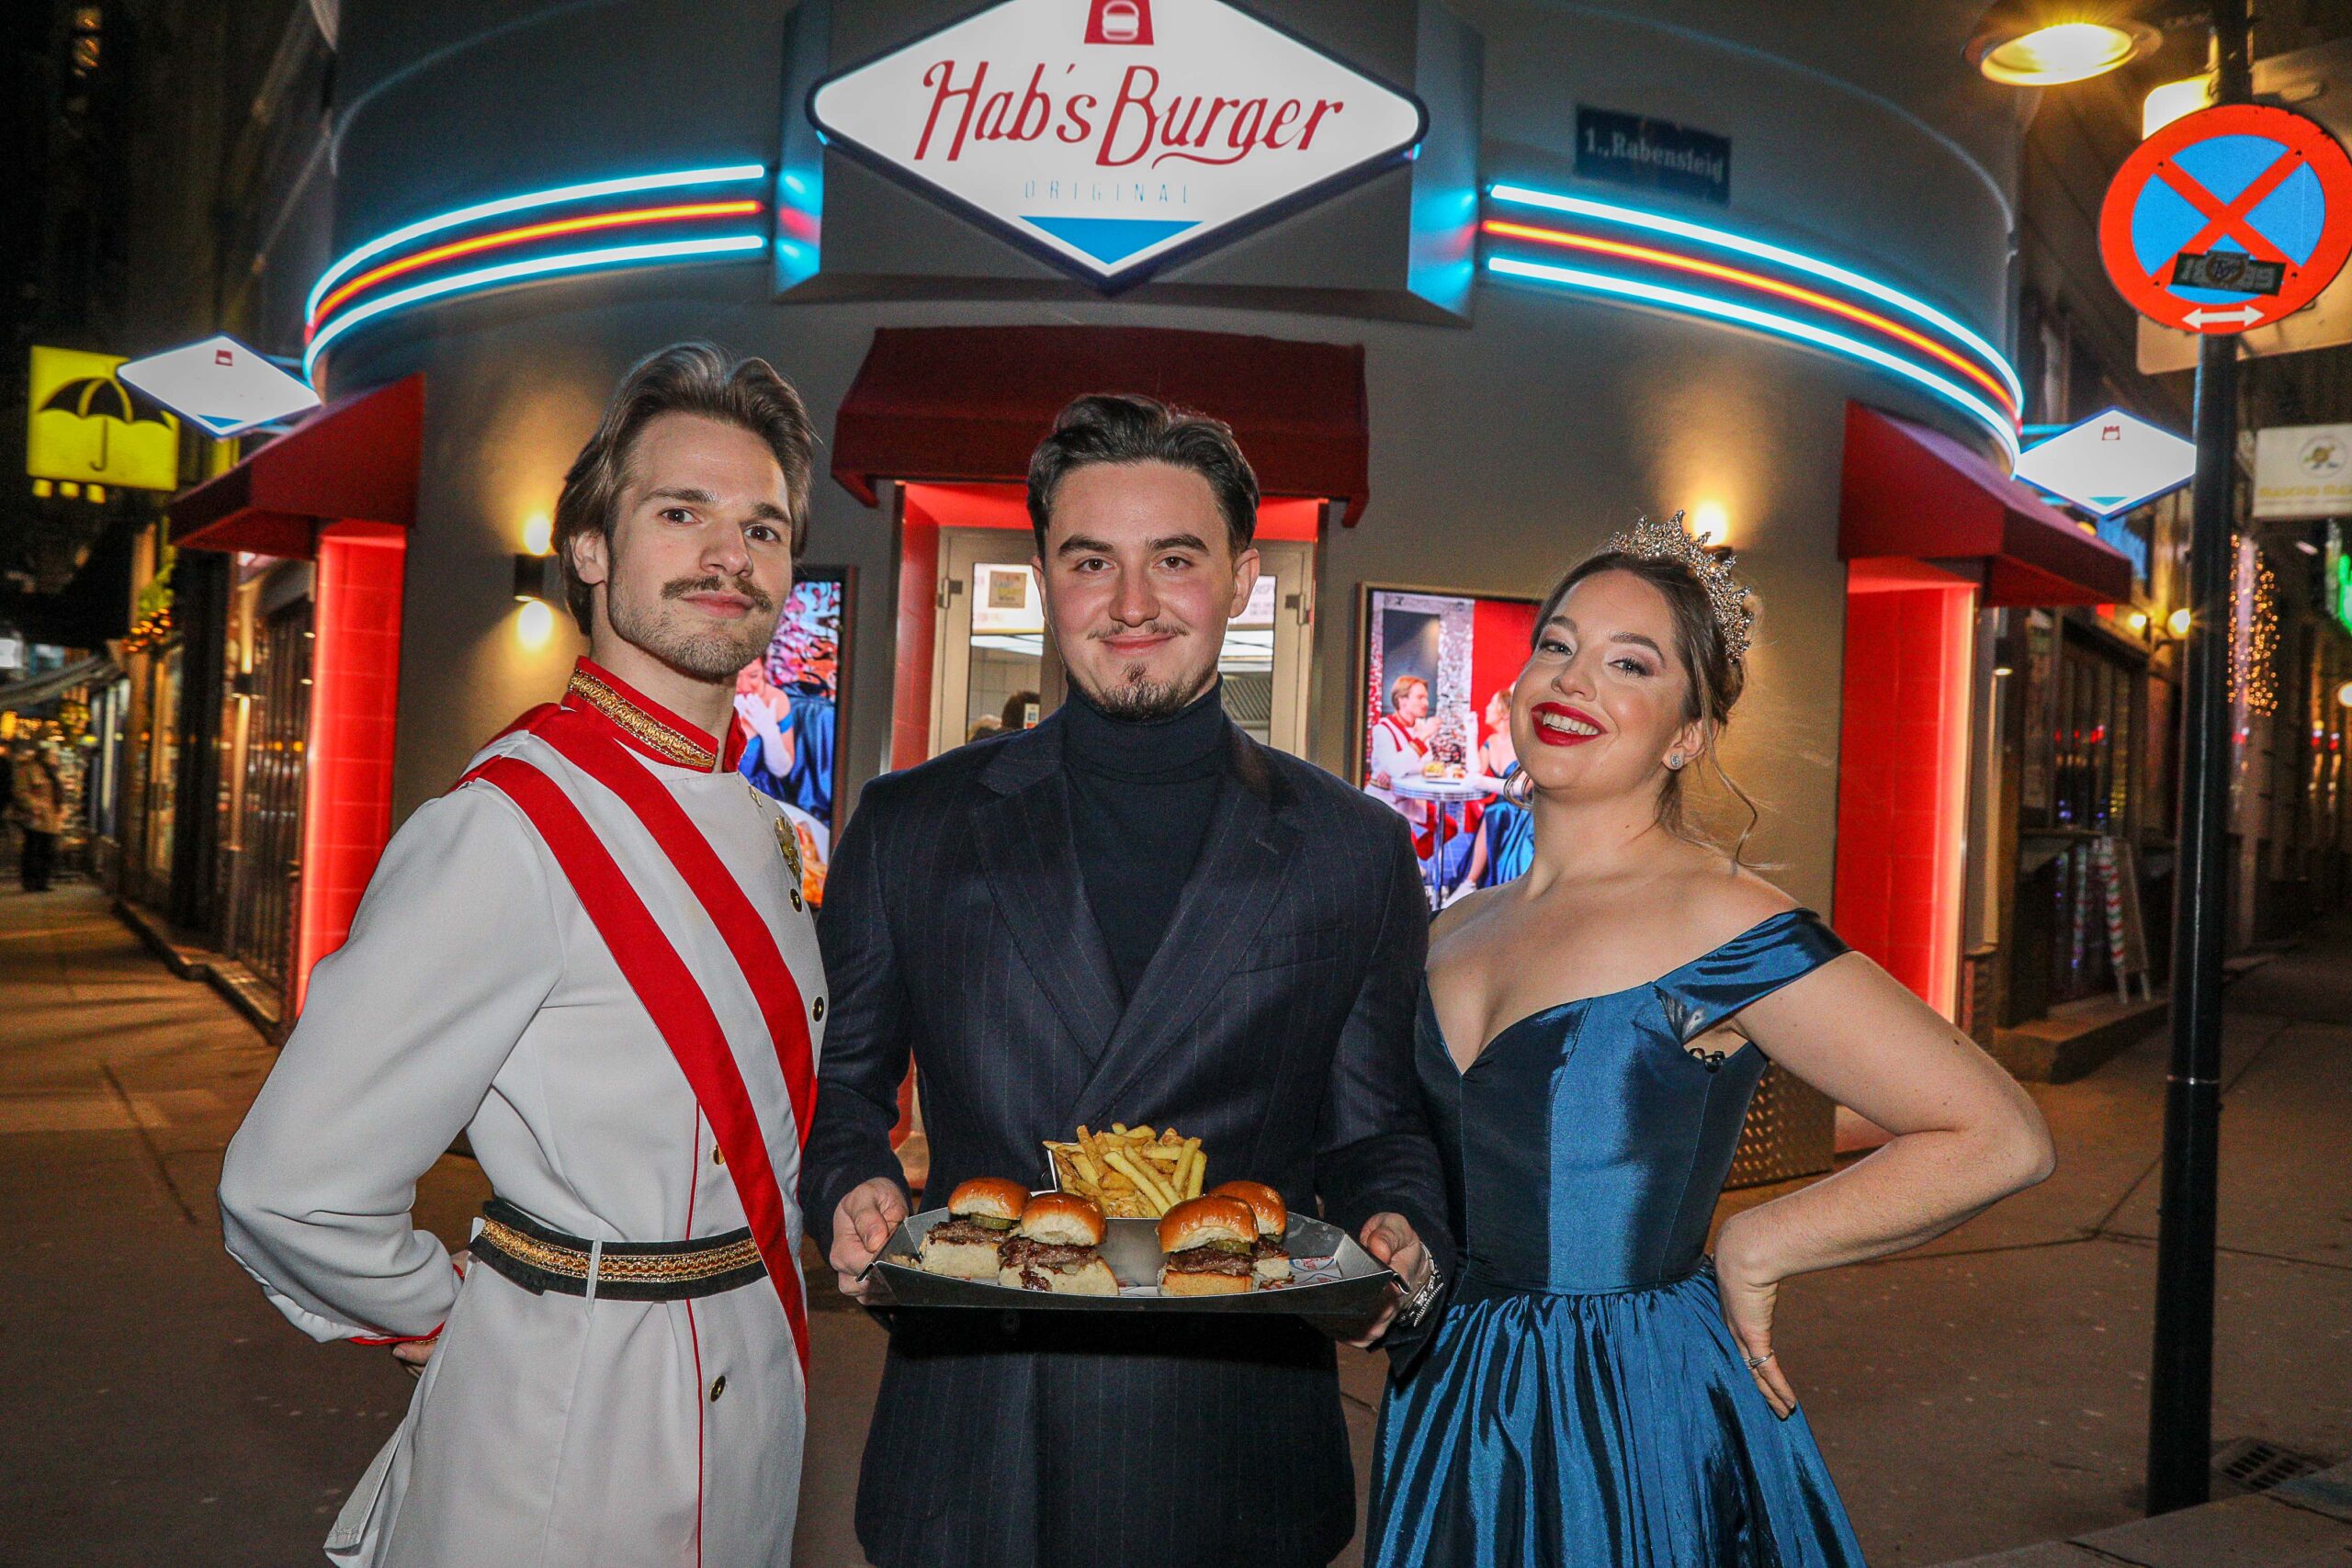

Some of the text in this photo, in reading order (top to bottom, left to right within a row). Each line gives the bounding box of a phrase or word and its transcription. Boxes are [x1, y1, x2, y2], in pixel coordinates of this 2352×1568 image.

[914, 60, 1343, 169] Hab's Burger
[1024, 179, 1189, 204] ORIGINAL
